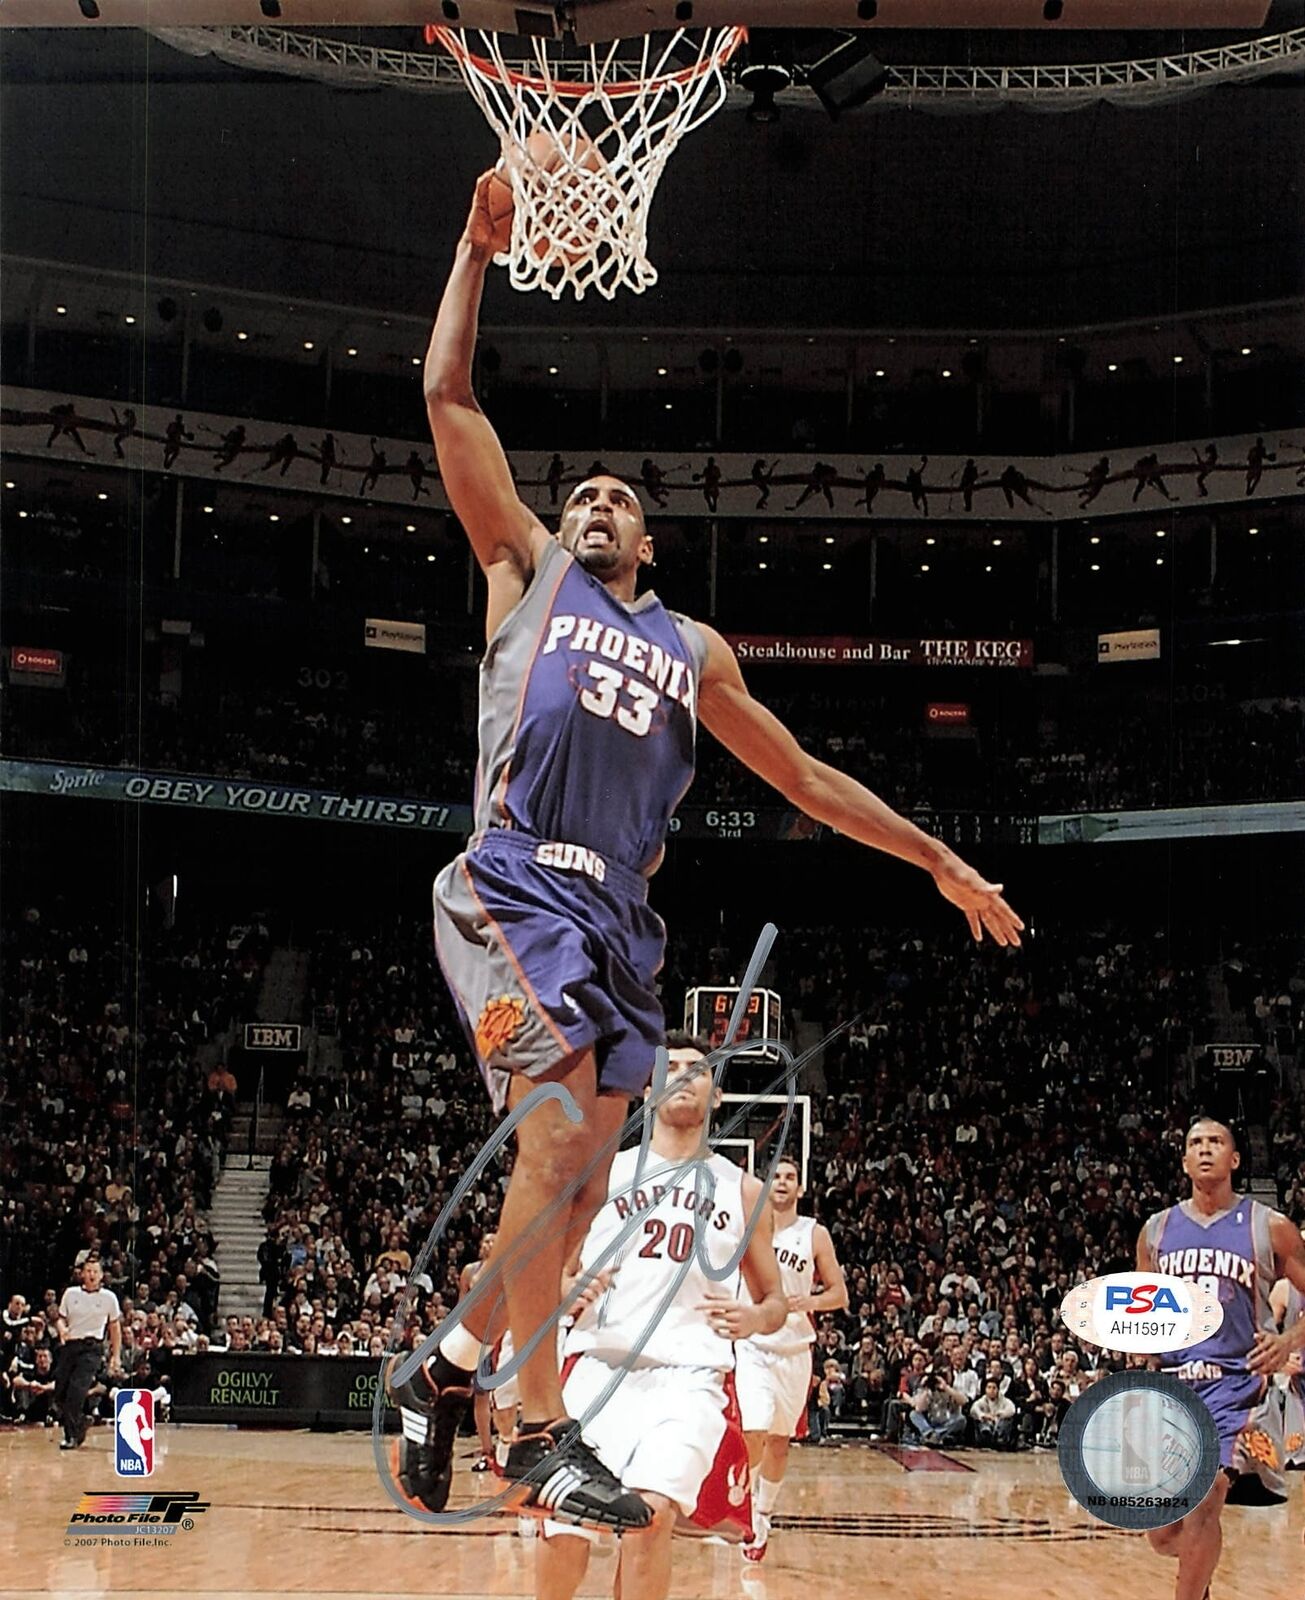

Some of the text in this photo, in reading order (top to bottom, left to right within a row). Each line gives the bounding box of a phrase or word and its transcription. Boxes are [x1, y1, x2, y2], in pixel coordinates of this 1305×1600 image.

[737, 640, 1022, 661] Steakhouse and Bar THE KEG
[542, 614, 696, 718] PHOENIX
[579, 659, 660, 737] 33
[50, 769, 104, 793] Sprite
[124, 777, 450, 828] OBEY YOUR THIRST!
[705, 810, 756, 827] 6:33
[718, 827, 742, 838] 3rd
[535, 842, 607, 882] SUNS
[252, 1028, 293, 1047] IBM
[1212, 1048, 1254, 1067] IBM
[613, 1185, 731, 1231] RAPTORS
[638, 1218, 695, 1263] 20
[1158, 1248, 1255, 1288] PHOENIX
[217, 1370, 274, 1389] OGILVY
[209, 1388, 280, 1406] RENAULT
